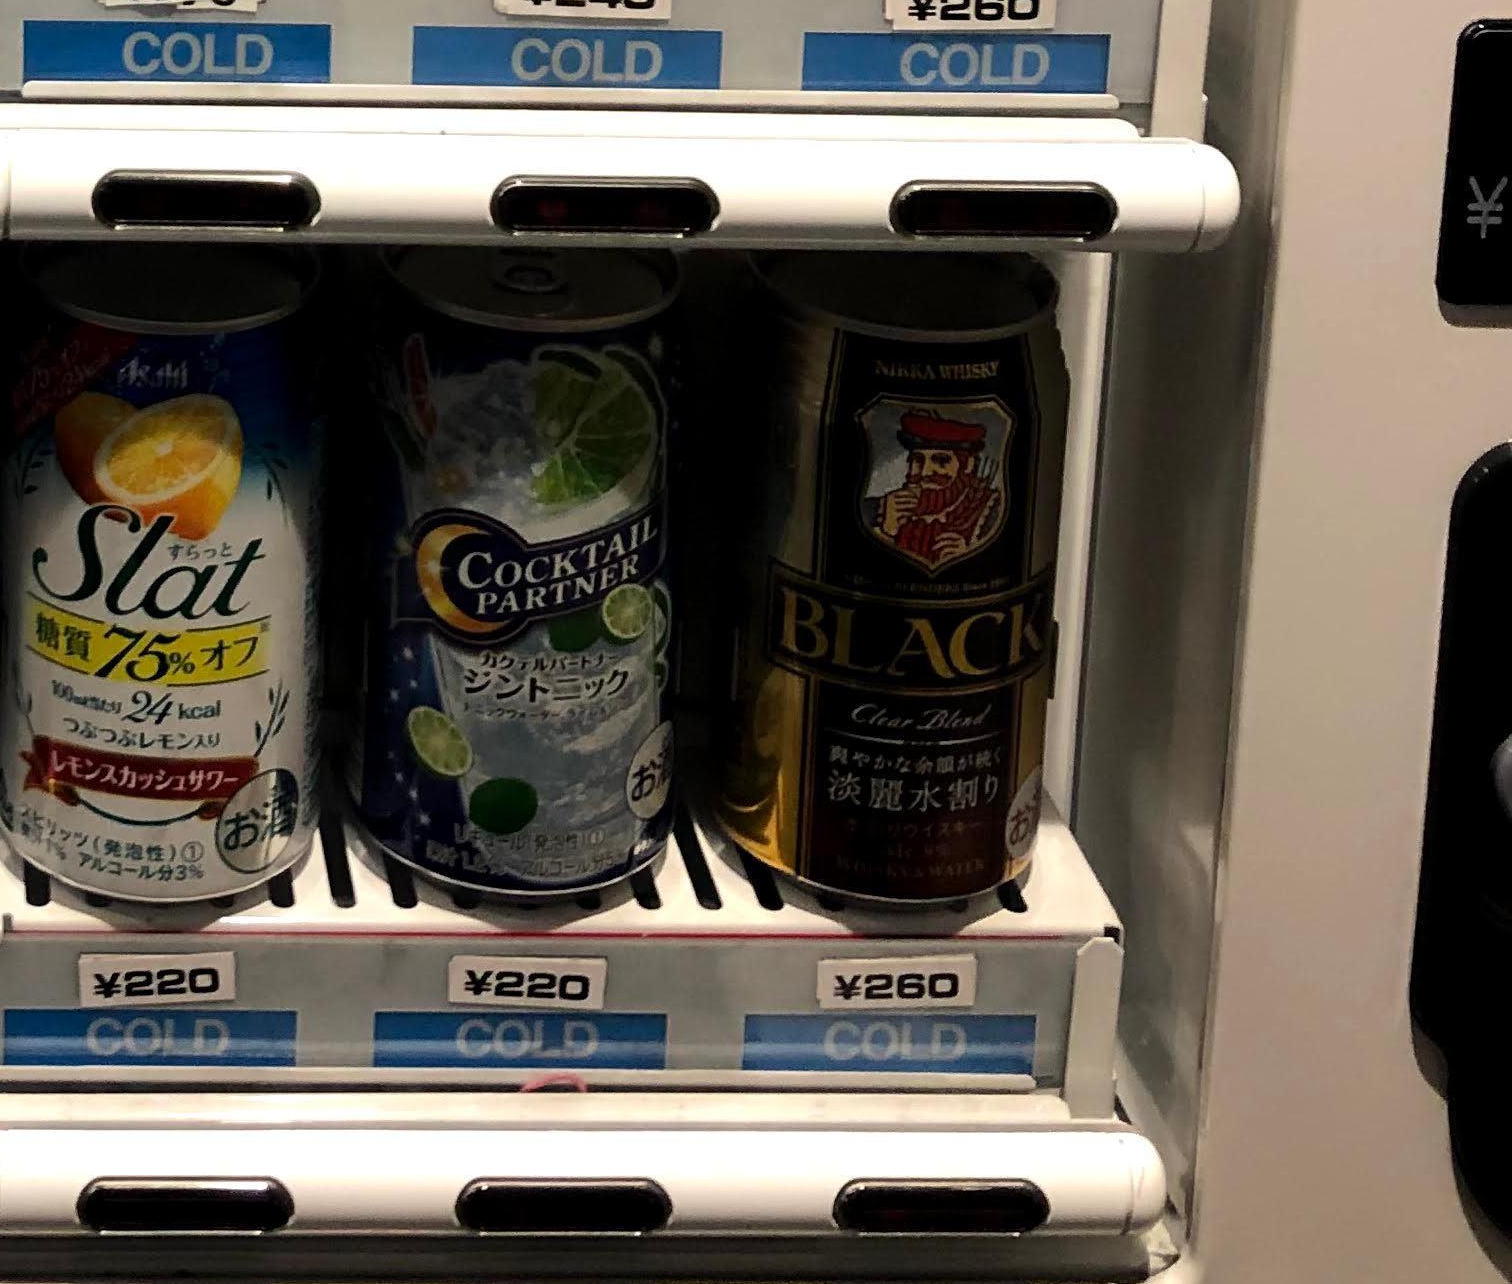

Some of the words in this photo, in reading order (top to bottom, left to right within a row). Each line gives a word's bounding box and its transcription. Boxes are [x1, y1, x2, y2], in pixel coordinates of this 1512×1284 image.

[122, 31, 273, 75] COLD
[511, 38, 663, 83] COLD
[899, 41, 1049, 86] COLD
[32, 505, 266, 619] Slat
[477, 553, 640, 615] PARTNER
[464, 668, 630, 703] ジントニック
[121, 689, 173, 725] 24
[178, 700, 221, 720] kcal
[93, 967, 220, 998] ¥220
[463, 969, 591, 1001] ¥220
[833, 972, 960, 1000] ¥260
[86, 1017, 230, 1057] COLD
[456, 1019, 601, 1059] COLD
[823, 1020, 968, 1062] COLD
